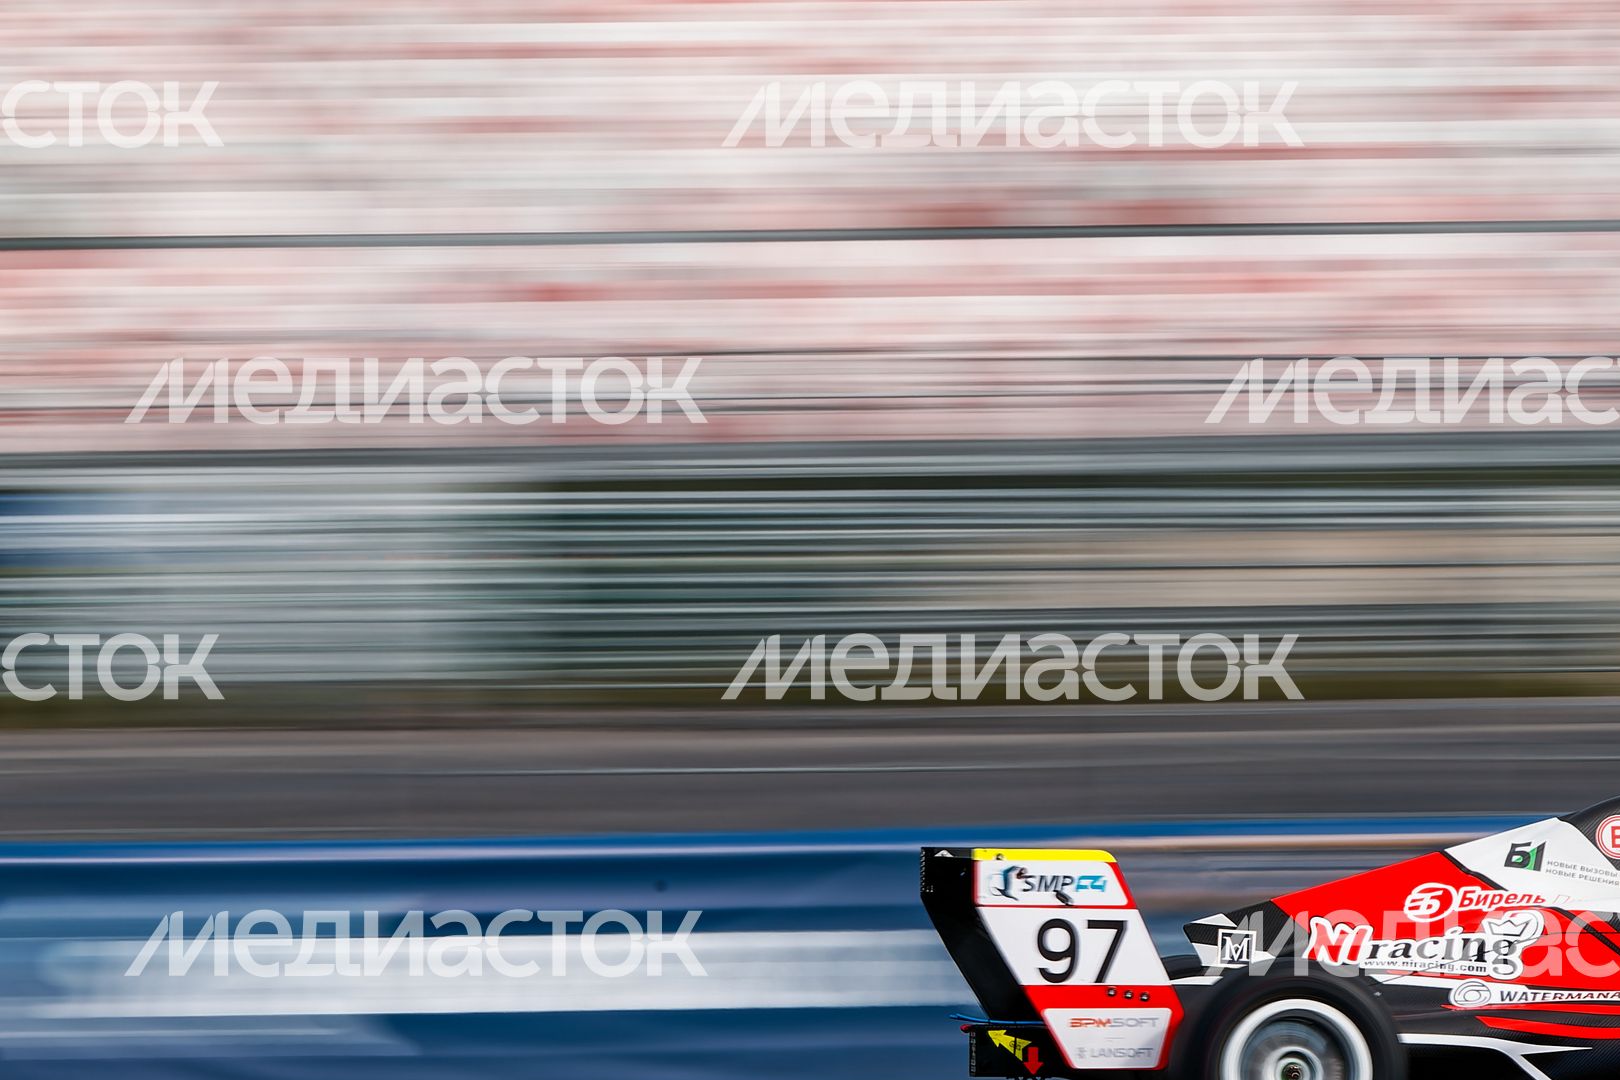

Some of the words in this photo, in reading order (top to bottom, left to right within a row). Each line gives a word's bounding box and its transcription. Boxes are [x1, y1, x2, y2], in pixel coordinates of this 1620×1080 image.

[1545, 868, 1577, 879] НОВЫЕ
[1579, 874, 1620, 886] РЕШЕНИЯ
[1547, 860, 1578, 870] НОВЫЕ
[1580, 866, 1618, 878] ВЫЗОВЫ
[1458, 888, 1546, 912] Бирель
[1036, 918, 1127, 984] 97
[1363, 958, 1487, 974] www.niracing.com
